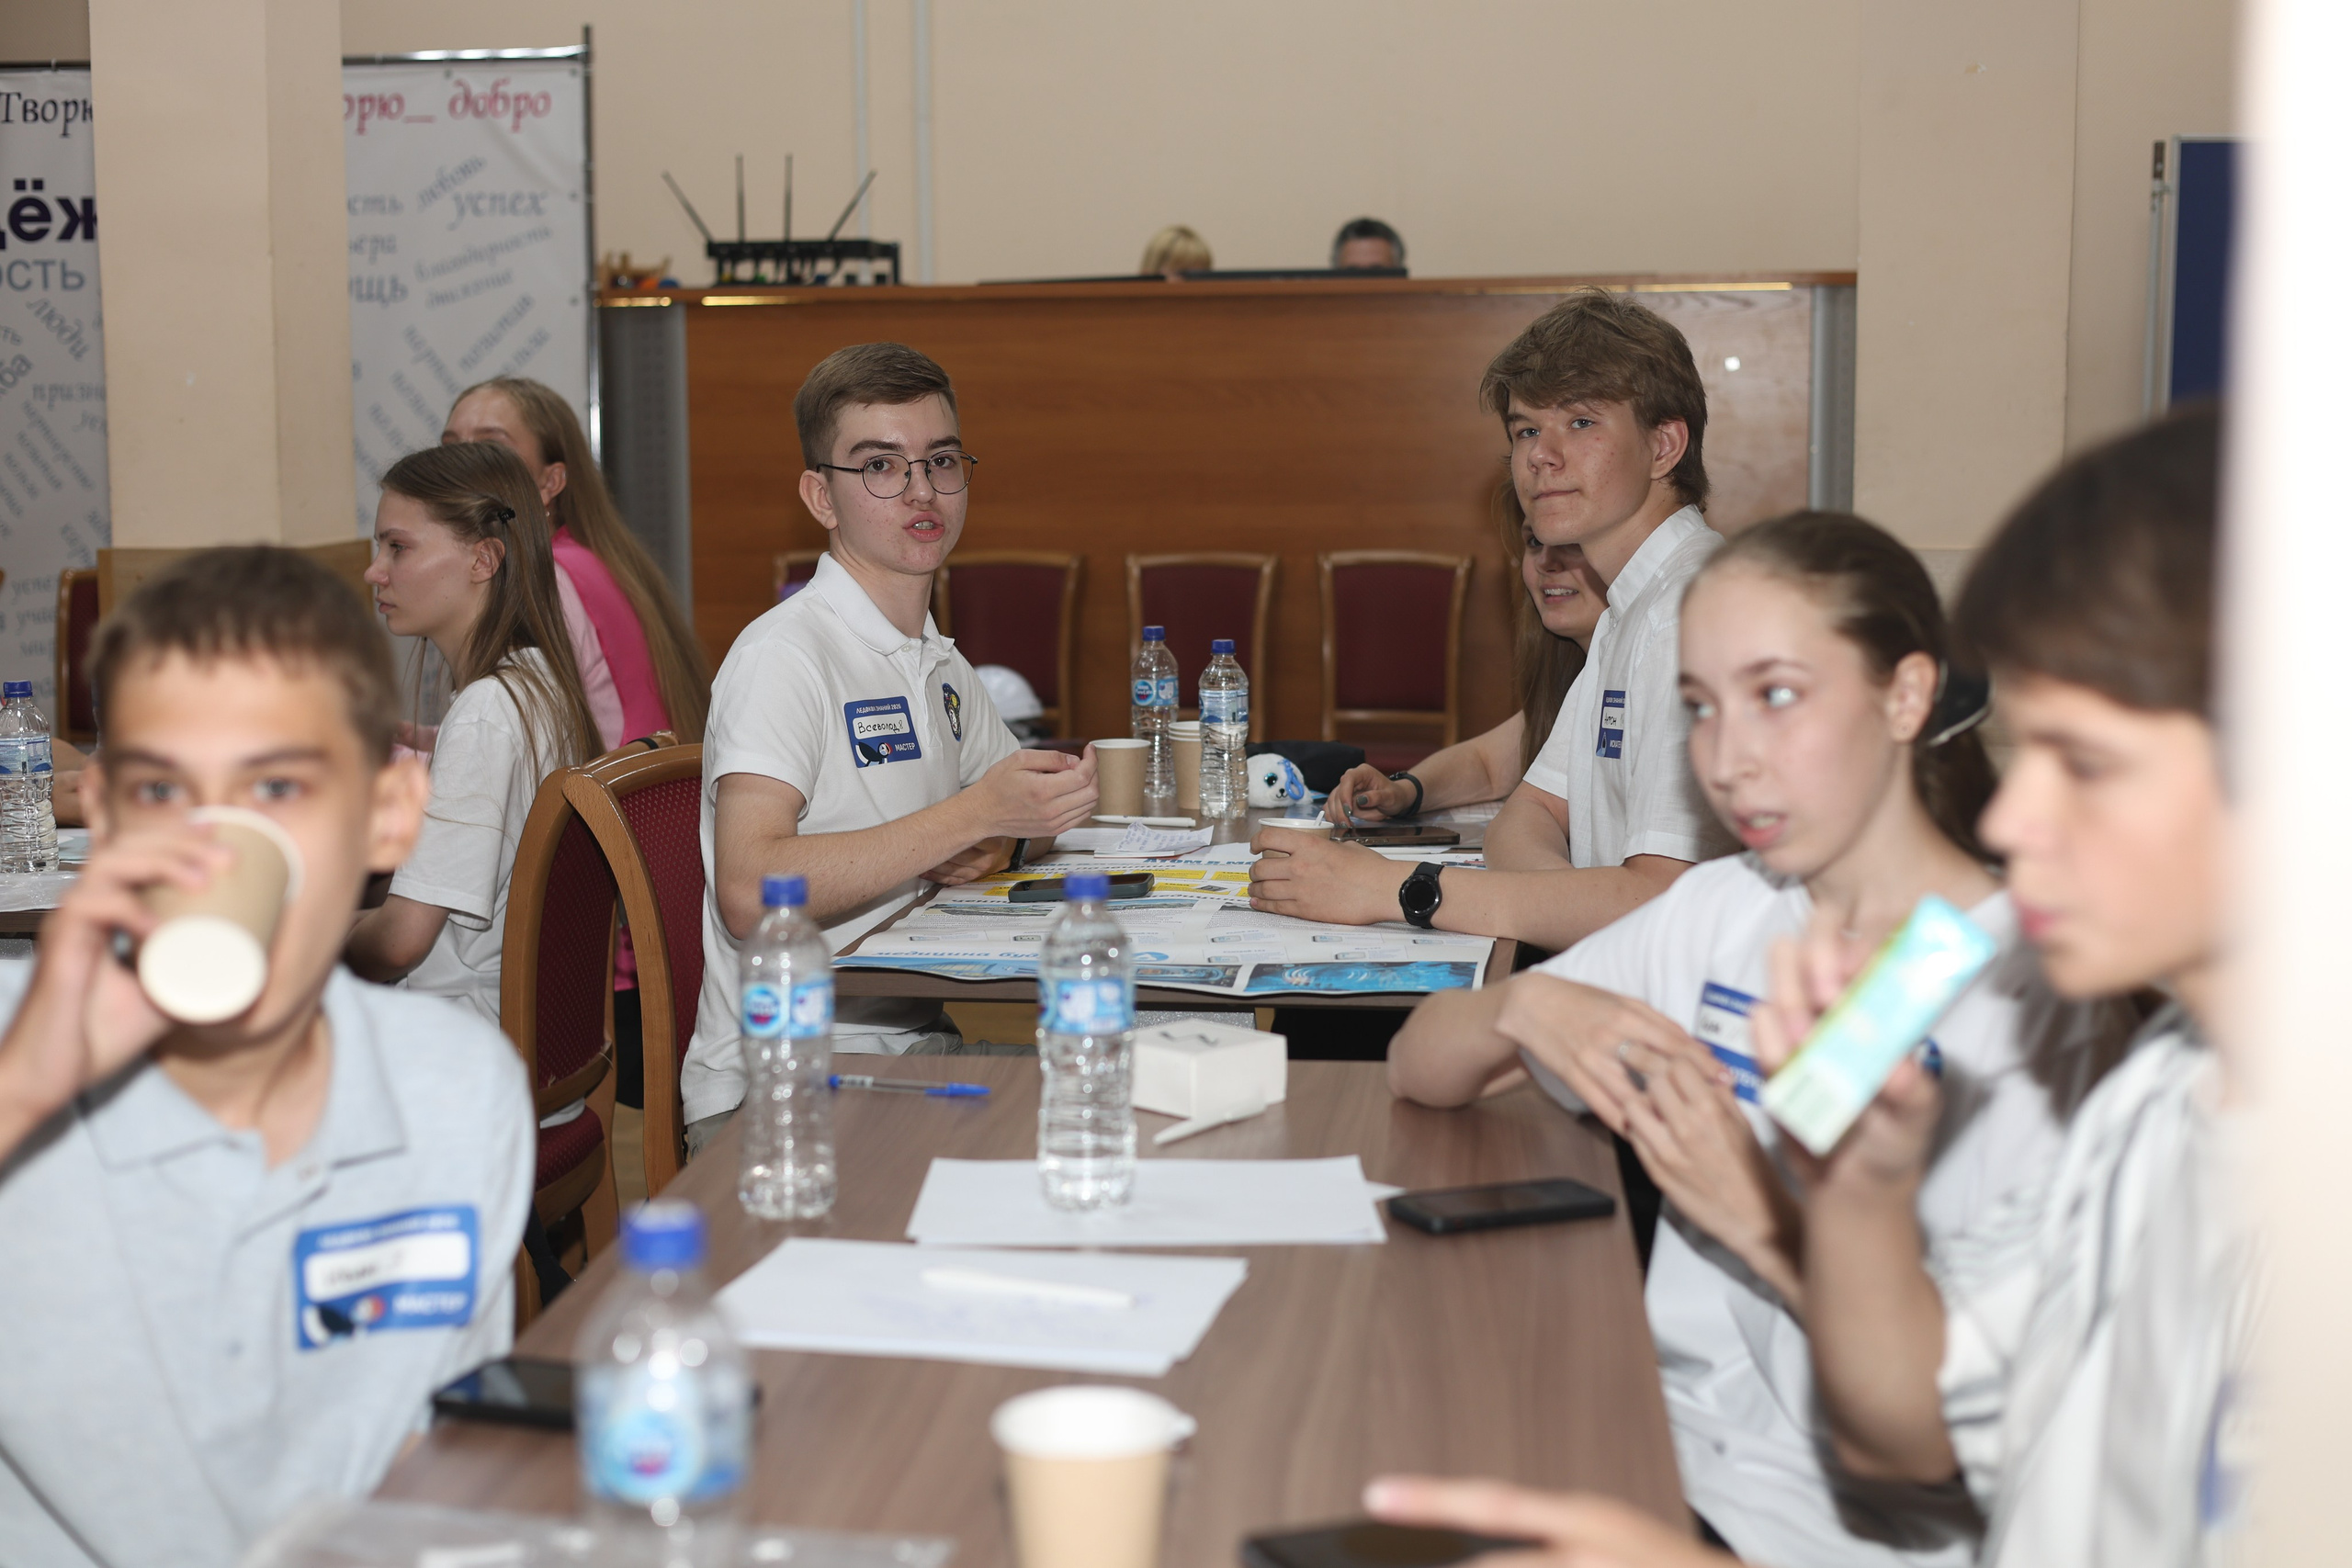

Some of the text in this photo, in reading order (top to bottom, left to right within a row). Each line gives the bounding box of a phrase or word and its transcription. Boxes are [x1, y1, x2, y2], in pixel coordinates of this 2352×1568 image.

[447, 77, 552, 133] добро
[0, 178, 98, 250] ёж
[447, 189, 549, 231] успех
[0, 258, 86, 292] сть
[25, 297, 90, 362] люди
[895, 742, 915, 751] МАСТЕР
